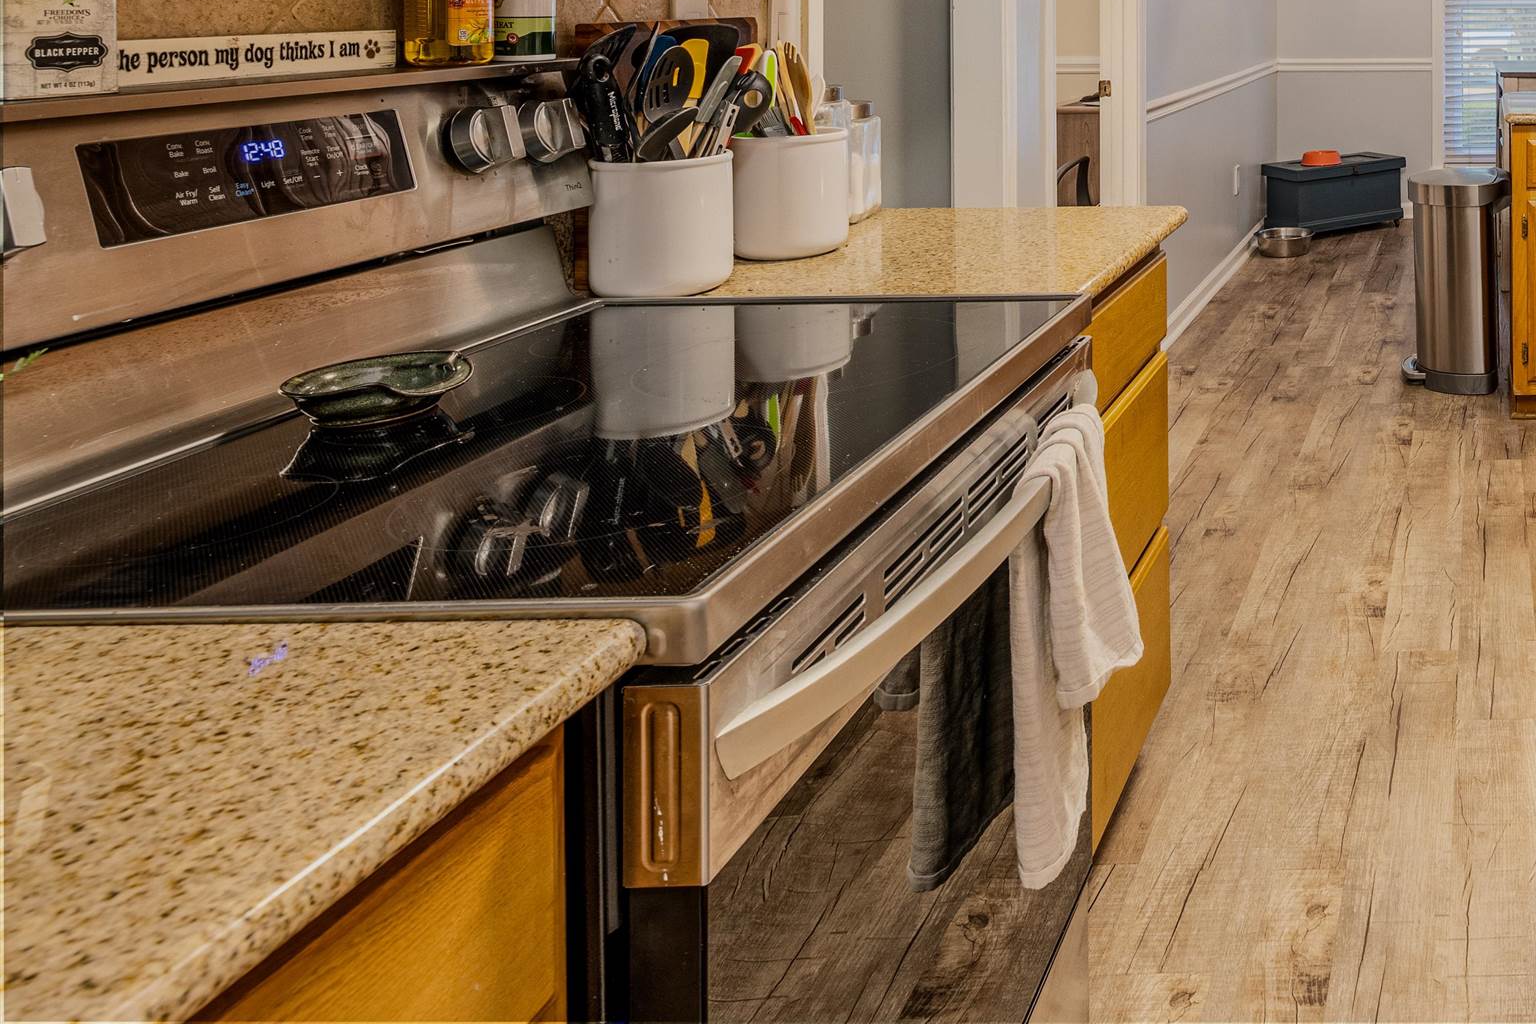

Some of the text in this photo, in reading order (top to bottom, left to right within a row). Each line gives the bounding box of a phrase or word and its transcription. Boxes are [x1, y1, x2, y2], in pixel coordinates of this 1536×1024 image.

[34, 47, 100, 58] BLACK PEPPER
[147, 49, 209, 73] person
[215, 47, 239, 71] my
[245, 43, 274, 68] dog
[279, 40, 325, 61] thinks
[329, 40, 335, 59] I
[339, 41, 361, 58] am
[609, 91, 623, 132] Microplane
[169, 150, 184, 158] Bake
[243, 139, 285, 162] 12:48
[305, 155, 319, 163] Start
[202, 166, 217, 174] Broil
[261, 180, 276, 189] Light
[282, 176, 303, 185] Set/Off
[208, 185, 221, 193] Self
[235, 182, 249, 190] Easy
[564, 181, 583, 191] ThinQ
[175, 188, 198, 199] Air Fry/
[208, 193, 225, 201] Clean
[180, 198, 198, 206] Warm
